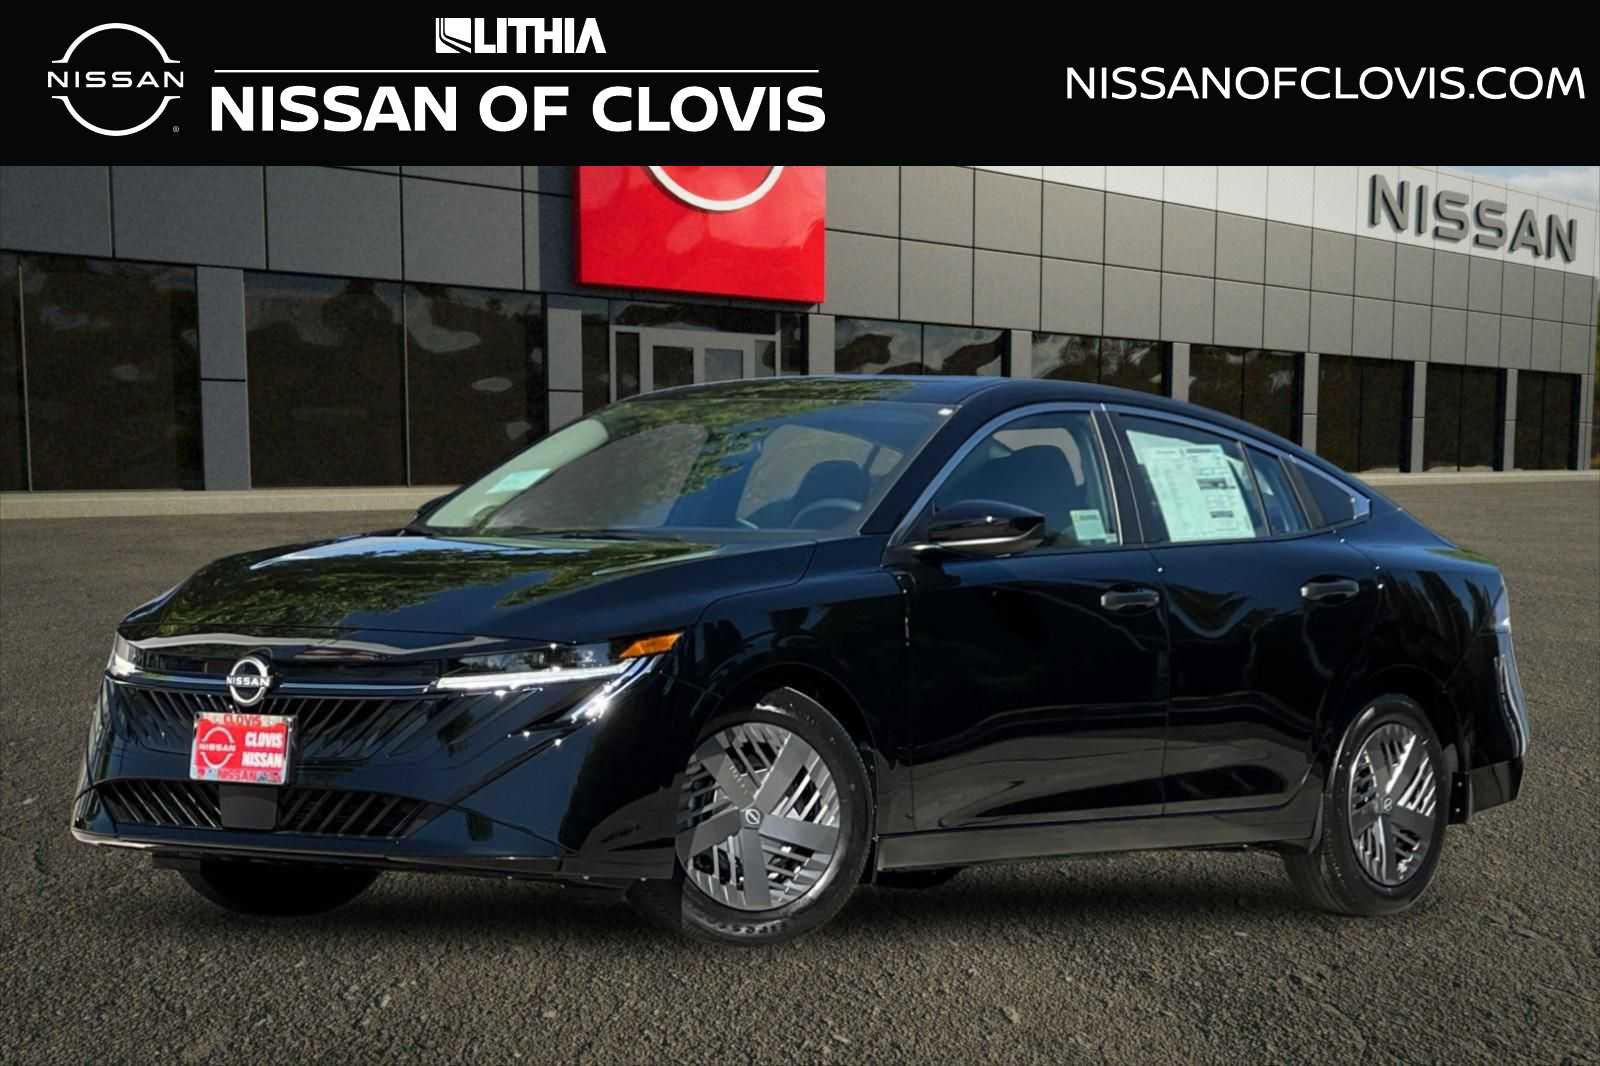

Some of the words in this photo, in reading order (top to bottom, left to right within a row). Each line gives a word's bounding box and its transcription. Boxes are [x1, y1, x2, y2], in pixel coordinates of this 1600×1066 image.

[1368, 173, 1578, 264] NISSAN
[226, 676, 270, 687] NISSAN
[199, 742, 237, 753] NISSAN
[245, 732, 283, 748] CLOVIS
[241, 751, 284, 768] NISSAN
